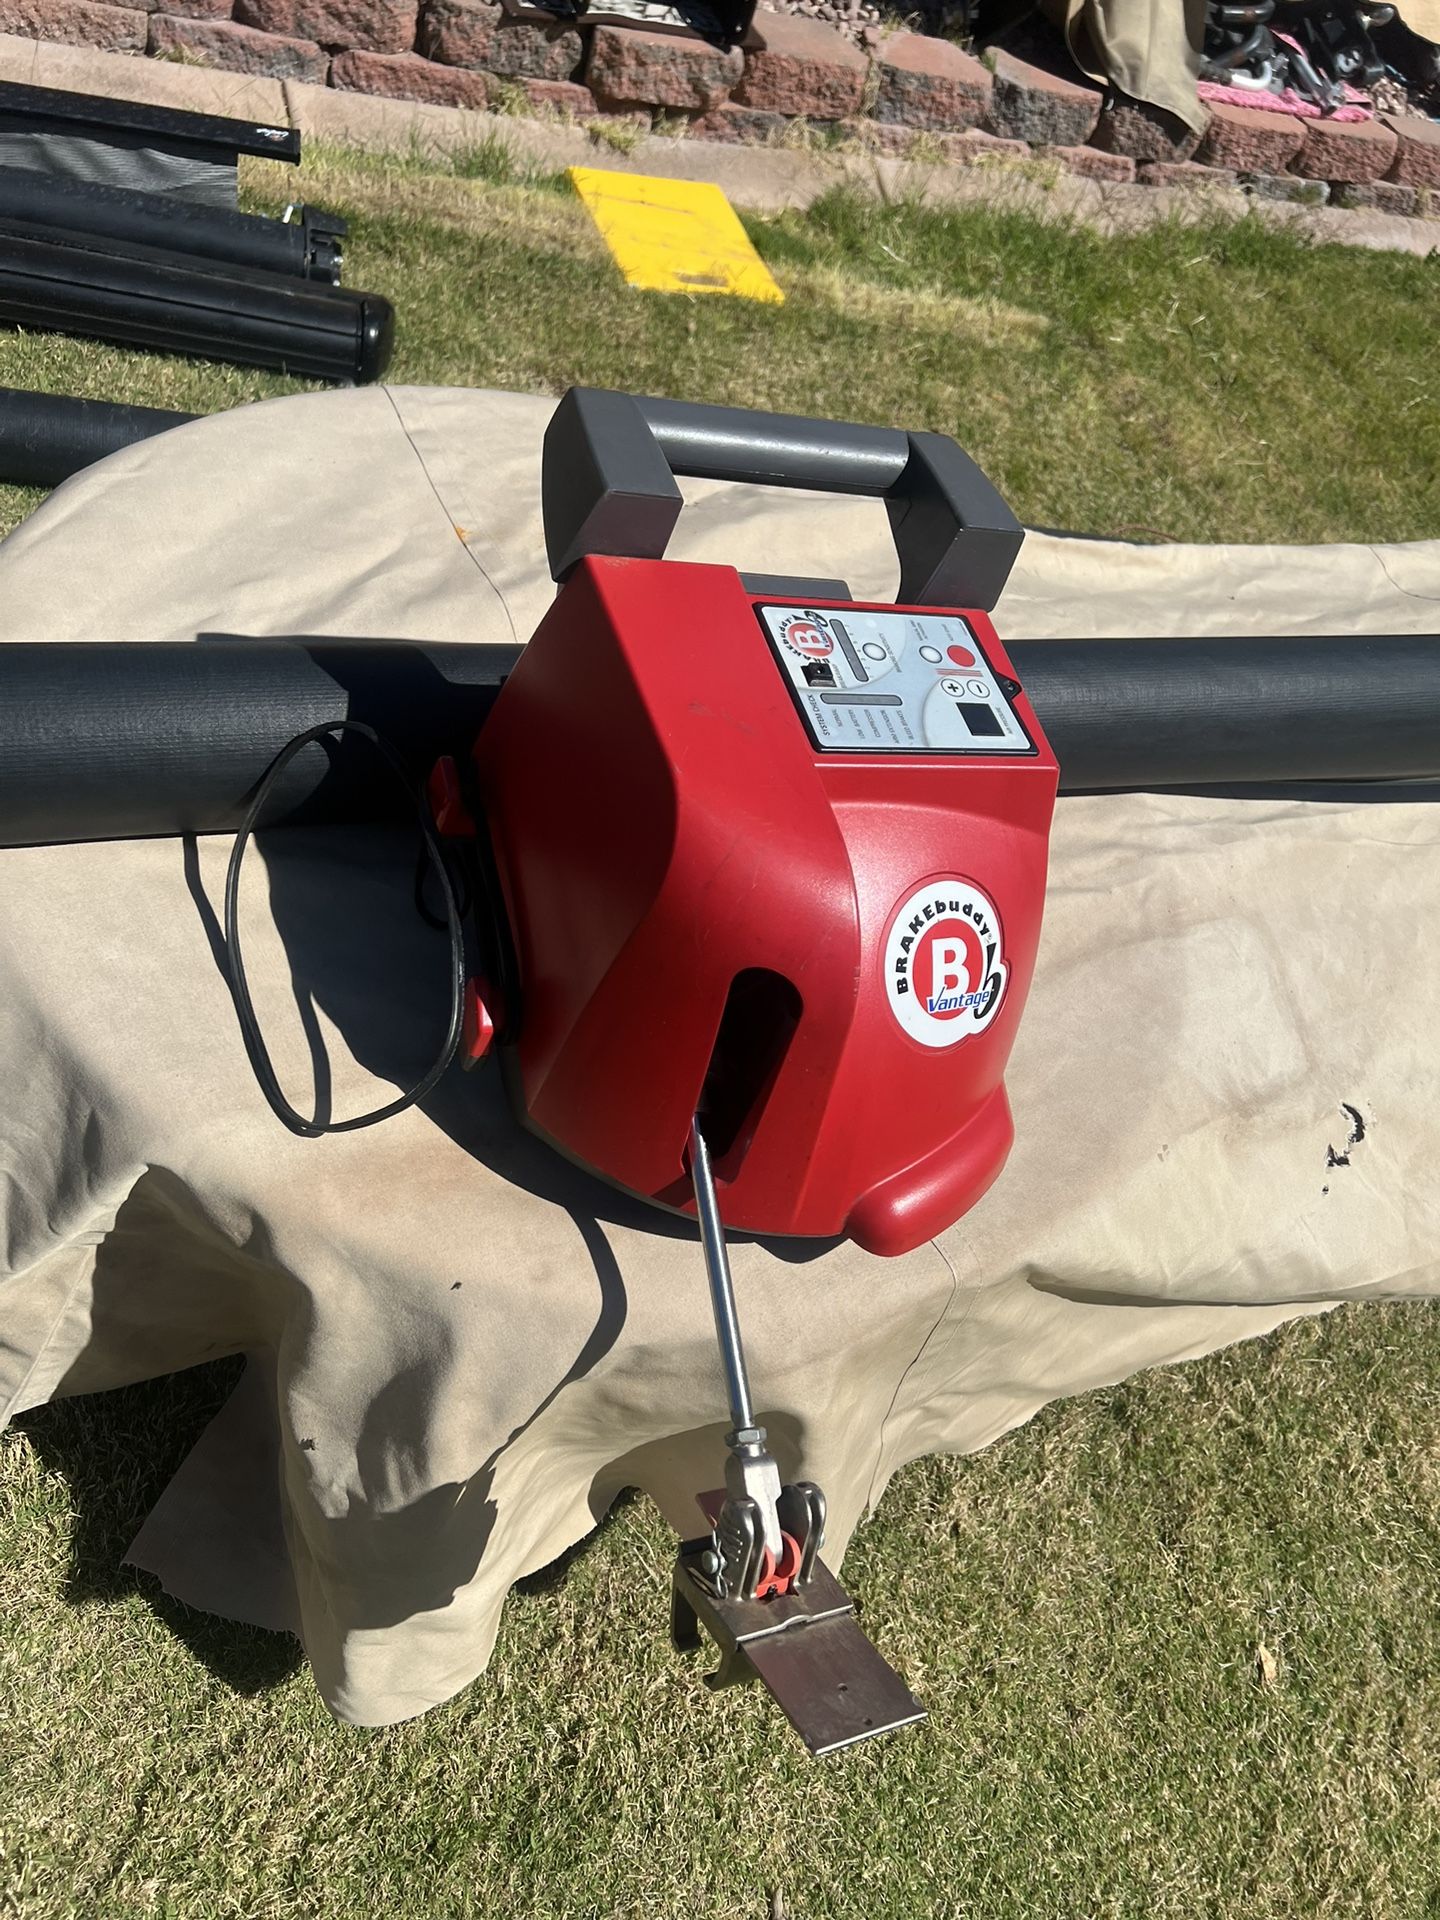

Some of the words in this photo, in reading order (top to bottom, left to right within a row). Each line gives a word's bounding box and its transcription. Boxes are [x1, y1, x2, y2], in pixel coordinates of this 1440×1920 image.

[807, 694, 820, 711] CHECK
[814, 713, 830, 736] SYSTEM
[896, 900, 990, 994] BRAKEbuddy
[932, 937, 970, 997] B
[928, 986, 991, 1012] Vantage
